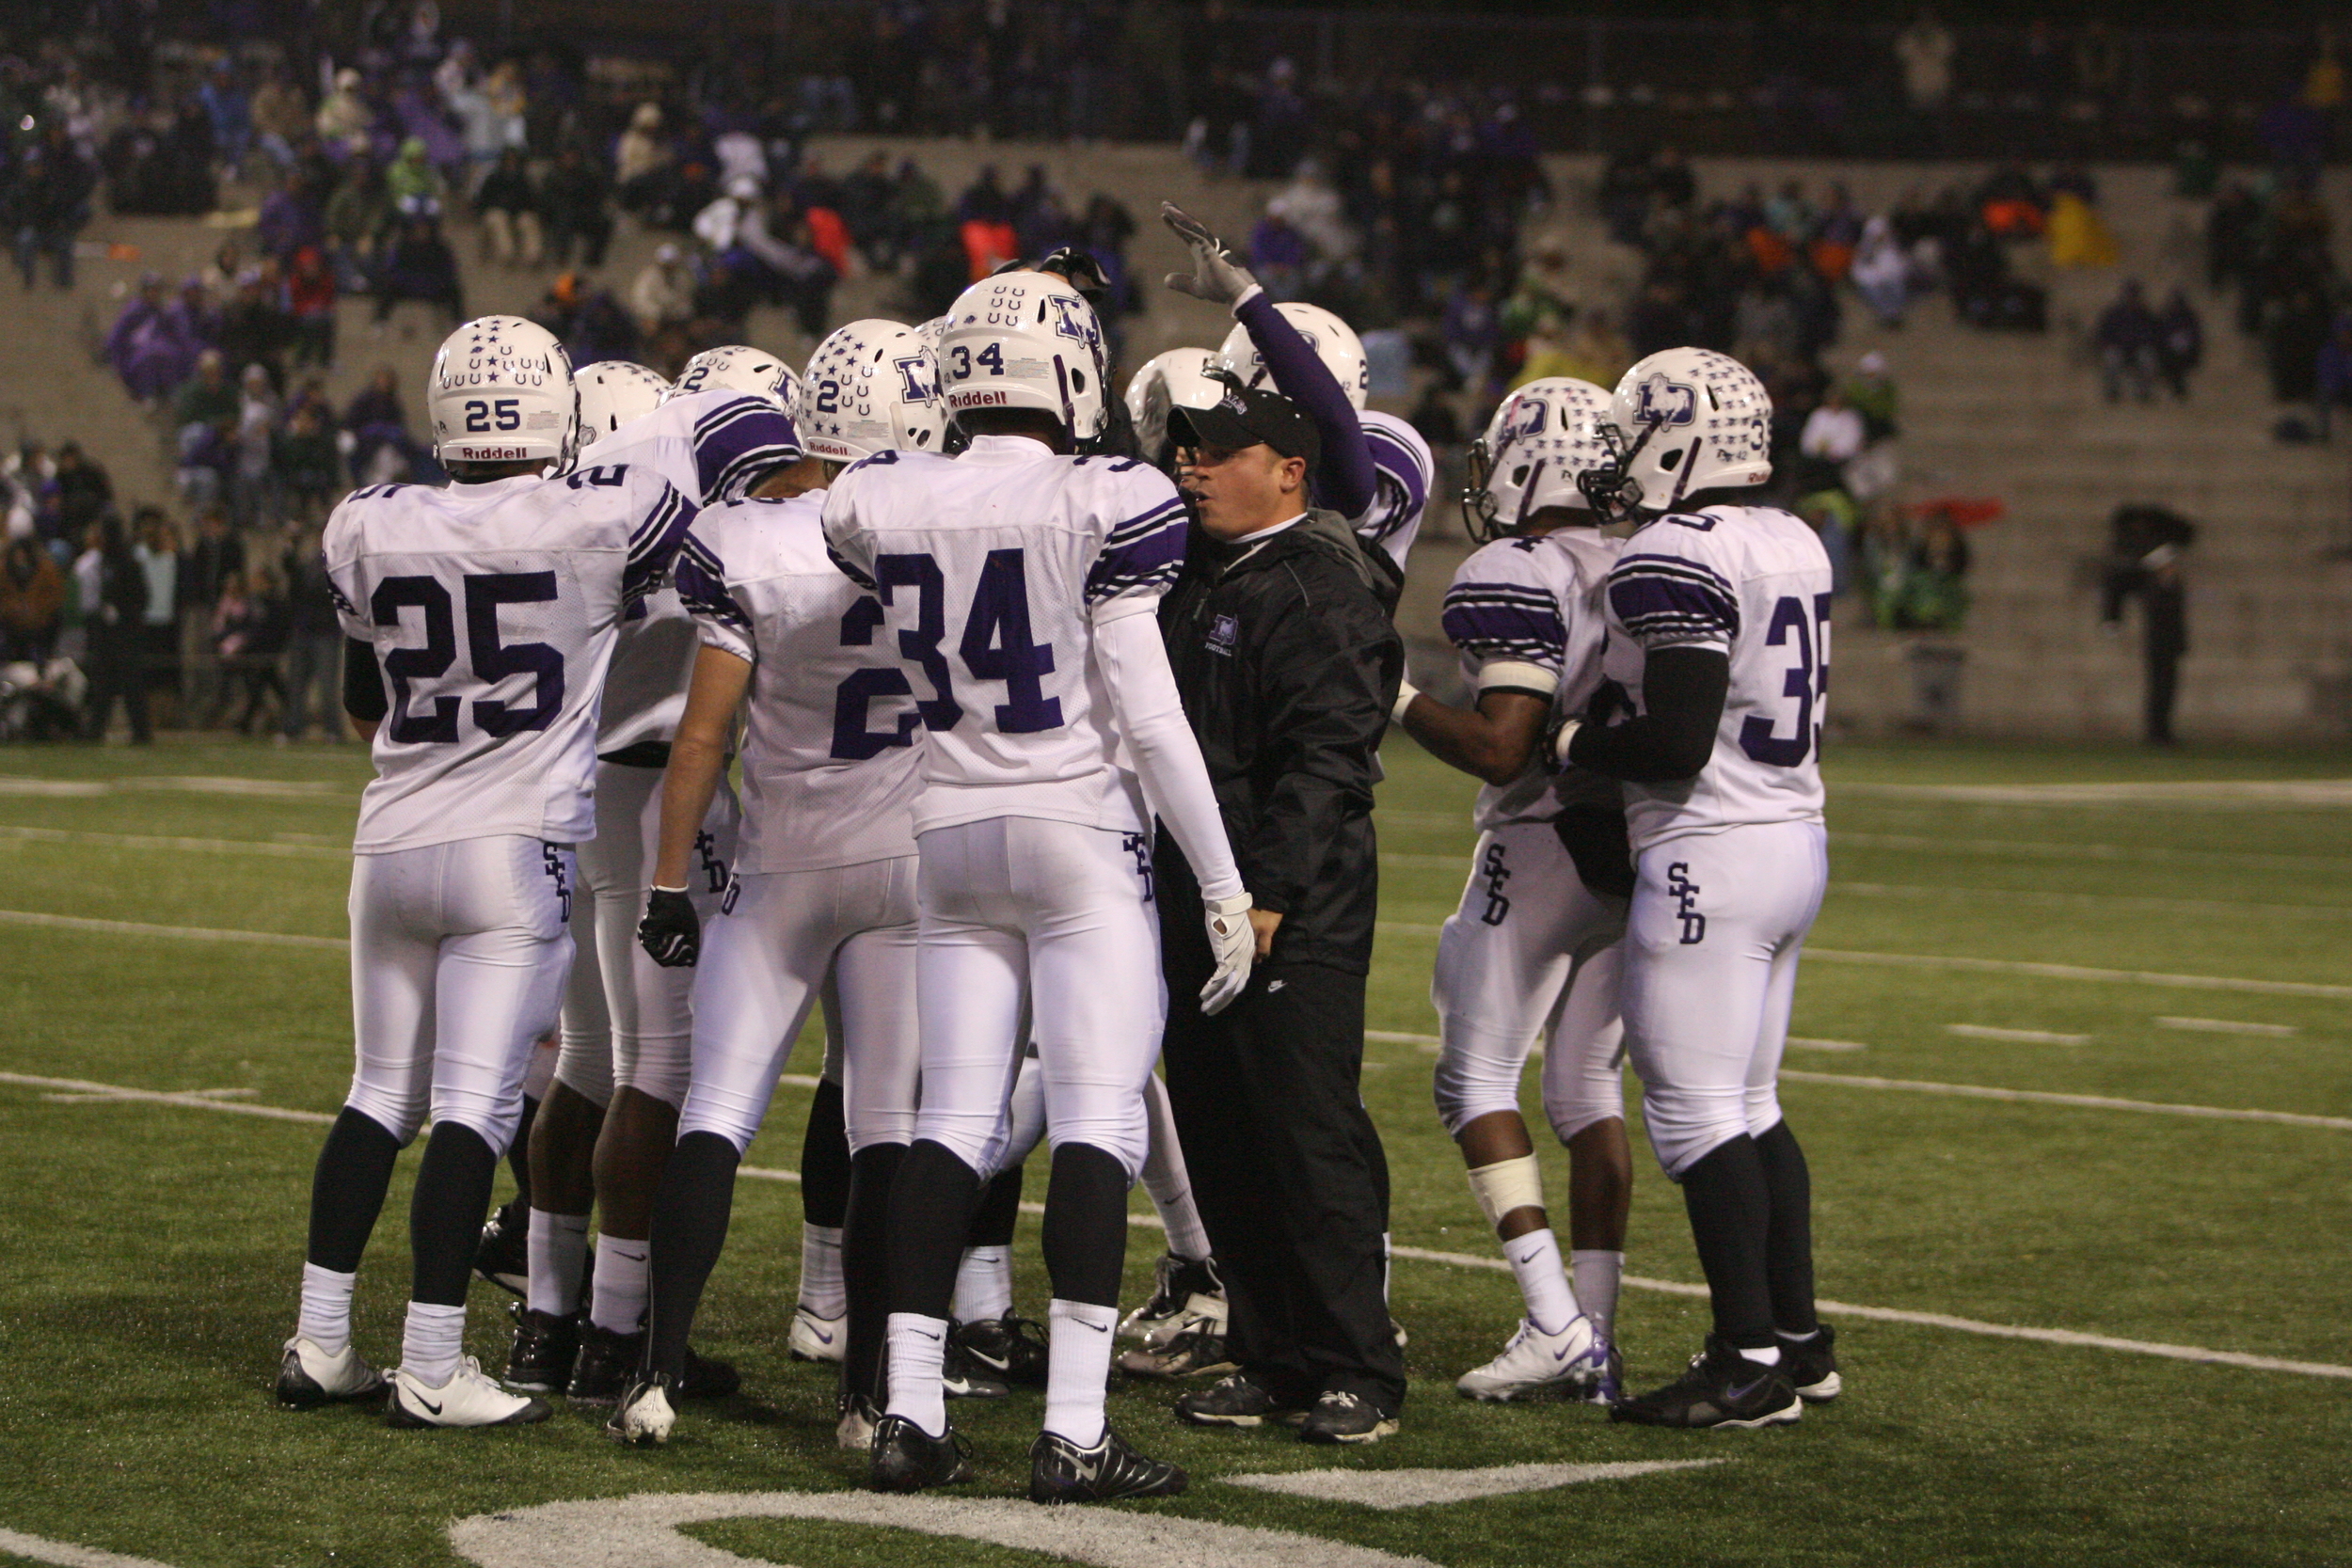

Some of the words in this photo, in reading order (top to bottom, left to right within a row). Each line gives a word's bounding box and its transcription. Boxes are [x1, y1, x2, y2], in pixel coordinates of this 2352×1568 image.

[951, 342, 1004, 380] 34
[816, 379, 840, 414] 2
[948, 391, 1007, 408] Riddell
[465, 400, 521, 432] 25
[463, 447, 528, 459] Riddell
[809, 441, 851, 456] Riddell
[371, 570, 564, 744] 25
[874, 547, 1066, 734] 34
[1204, 641, 1232, 657] FOOTBALL
[693, 829, 729, 894] FD
